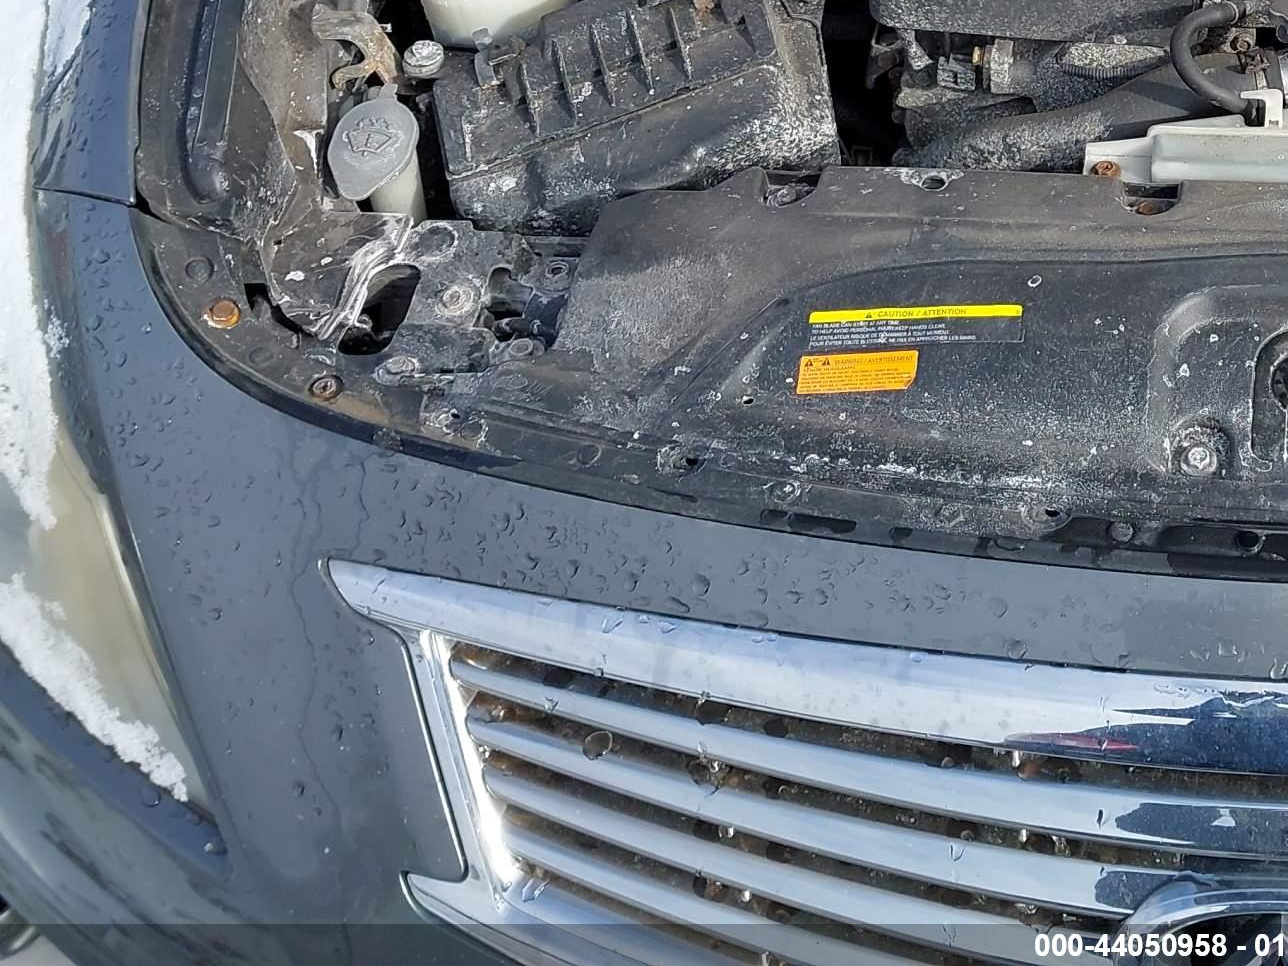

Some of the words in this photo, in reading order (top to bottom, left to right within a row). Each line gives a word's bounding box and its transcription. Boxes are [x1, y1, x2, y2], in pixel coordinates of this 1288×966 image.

[877, 310, 914, 318] CAUTION
[921, 308, 967, 317] ATTENTION
[868, 355, 914, 363] AVERTISSEMENT
